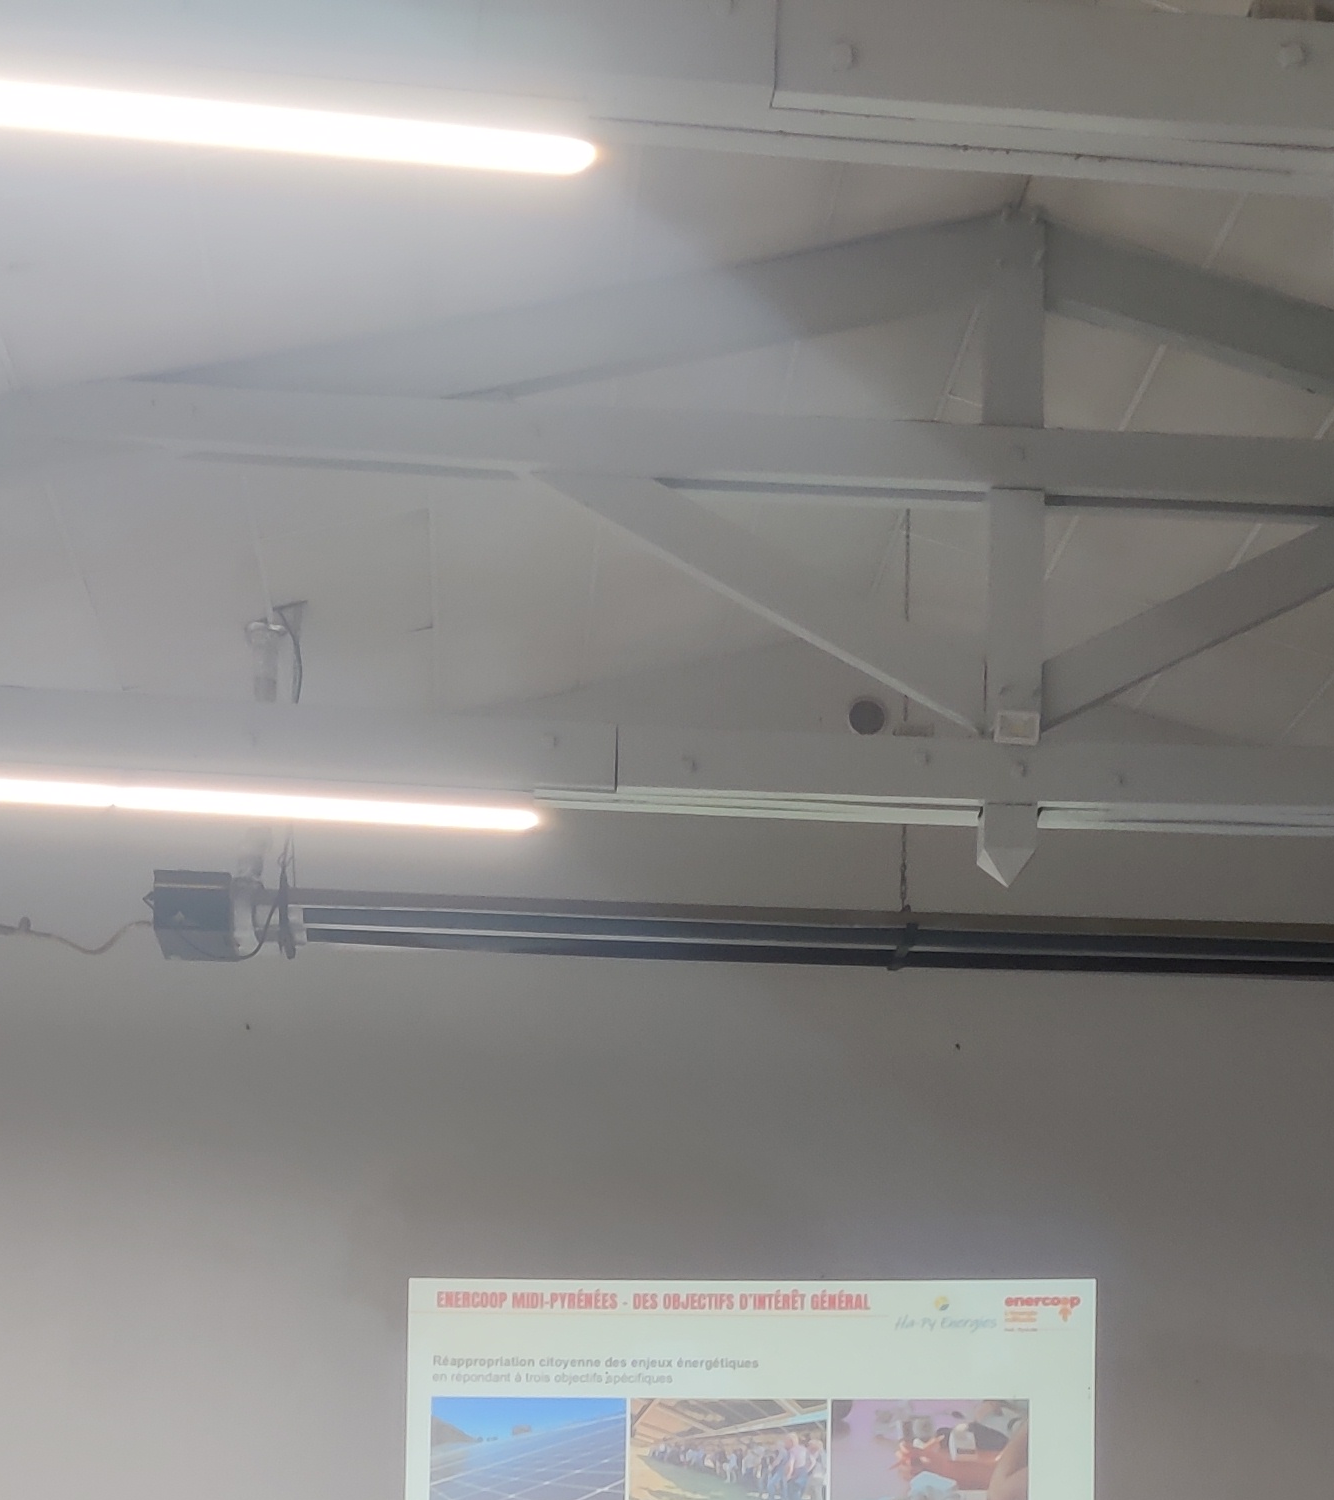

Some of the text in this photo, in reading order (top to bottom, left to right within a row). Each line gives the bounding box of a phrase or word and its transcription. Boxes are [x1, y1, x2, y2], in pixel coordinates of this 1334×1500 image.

[437, 1291, 507, 1308] ENERCOOP
[512, 1289, 617, 1310] MIDI-PYRÉNÉES
[633, 1293, 658, 1310] DES
[663, 1293, 734, 1310] OBJECTIFS
[740, 1289, 806, 1310] D'INTÉRÊT
[811, 1289, 871, 1311] GÉNÉRAL
[1004, 1295, 1081, 1309] enercoop
[433, 1355, 759, 1370] Réappropriation citoyenne des enjeux énergétiques
[432, 1373, 447, 1382] en
[451, 1371, 511, 1384] répondant
[526, 1372, 550, 1383] trois
[554, 1372, 603, 1384] objectifs
[606, 1372, 673, 1385] spécifiques
